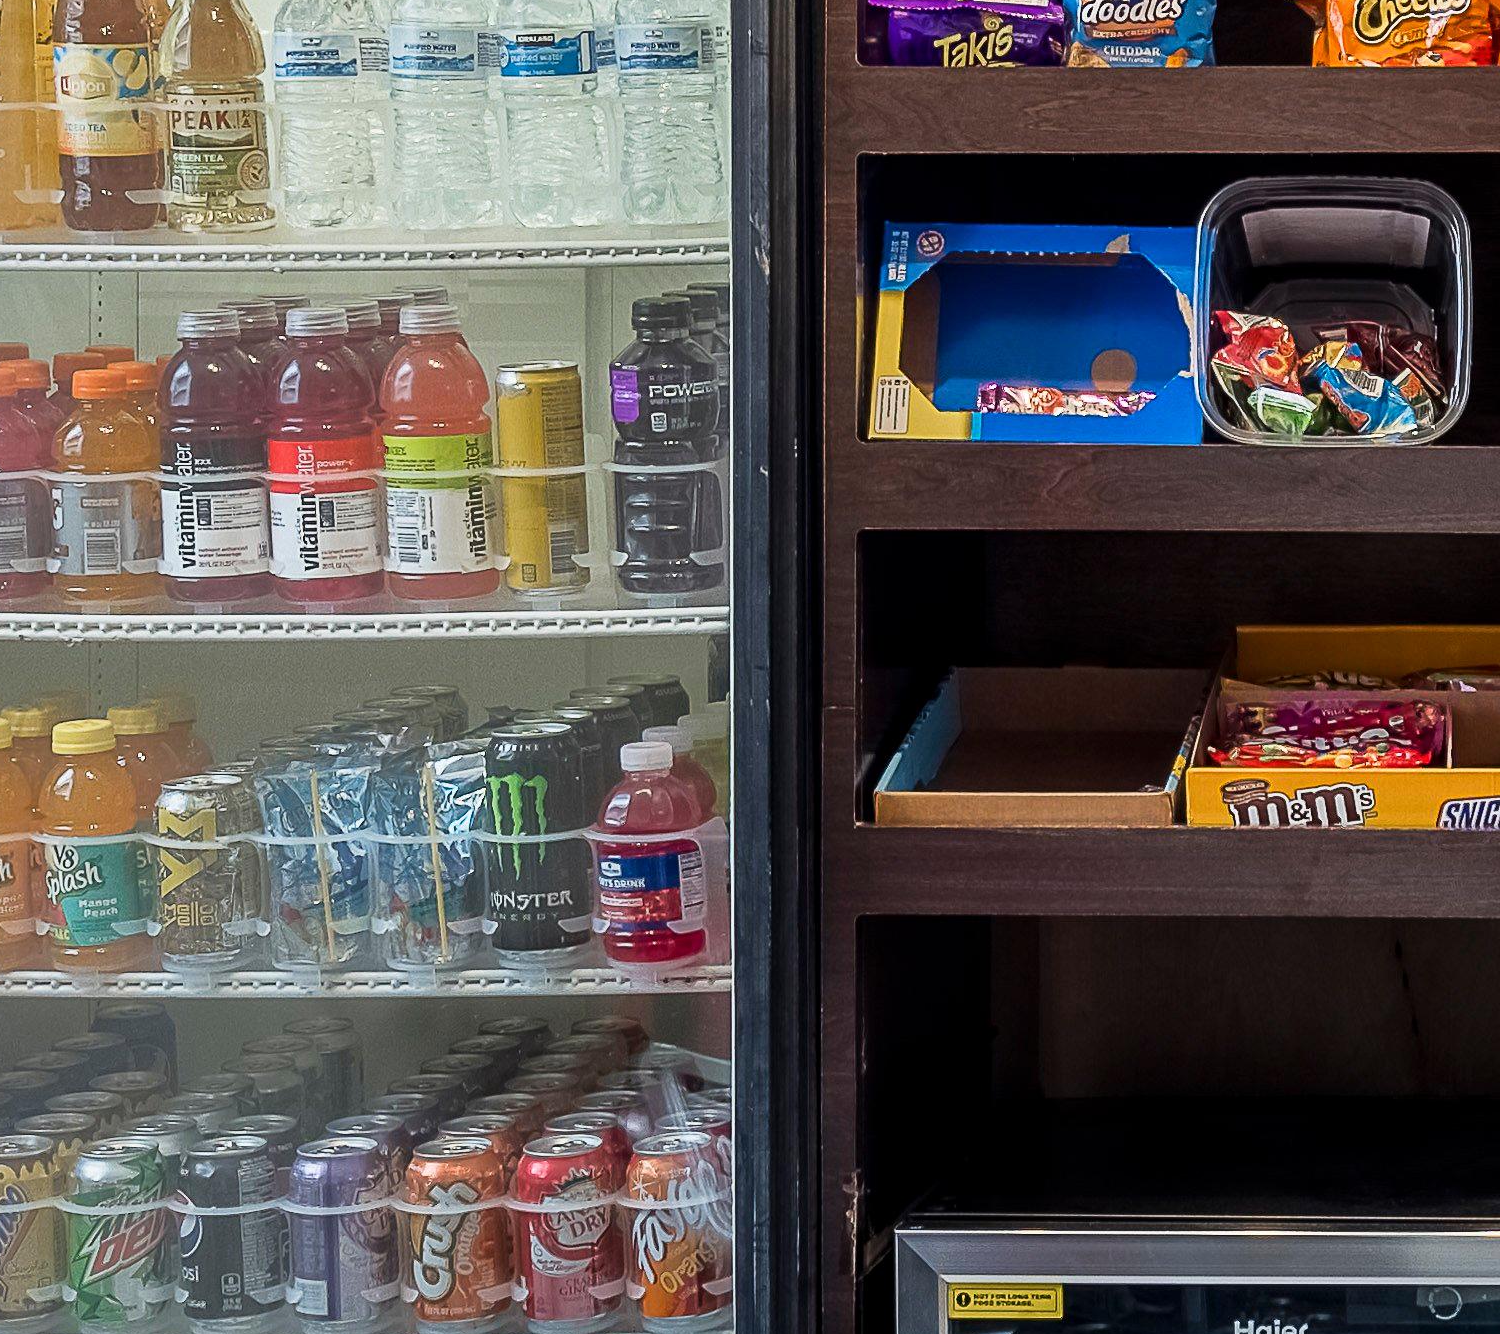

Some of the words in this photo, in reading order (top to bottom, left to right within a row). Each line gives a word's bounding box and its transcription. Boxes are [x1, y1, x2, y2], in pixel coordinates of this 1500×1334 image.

[933, 18, 1014, 67] Takis
[1103, 45, 1161, 57] CHEDDAR
[61, 77, 106, 95] Lipton
[89, 123, 107, 132] TEA
[171, 110, 231, 130] PEAK
[173, 153, 202, 163] GREEN
[204, 154, 224, 163] TEA
[53, 844, 74, 865] V8
[46, 864, 102, 902] Splash
[78, 897, 117, 908] Mango
[84, 907, 118, 917] Peach
[413, 1182, 478, 1299] Crush
